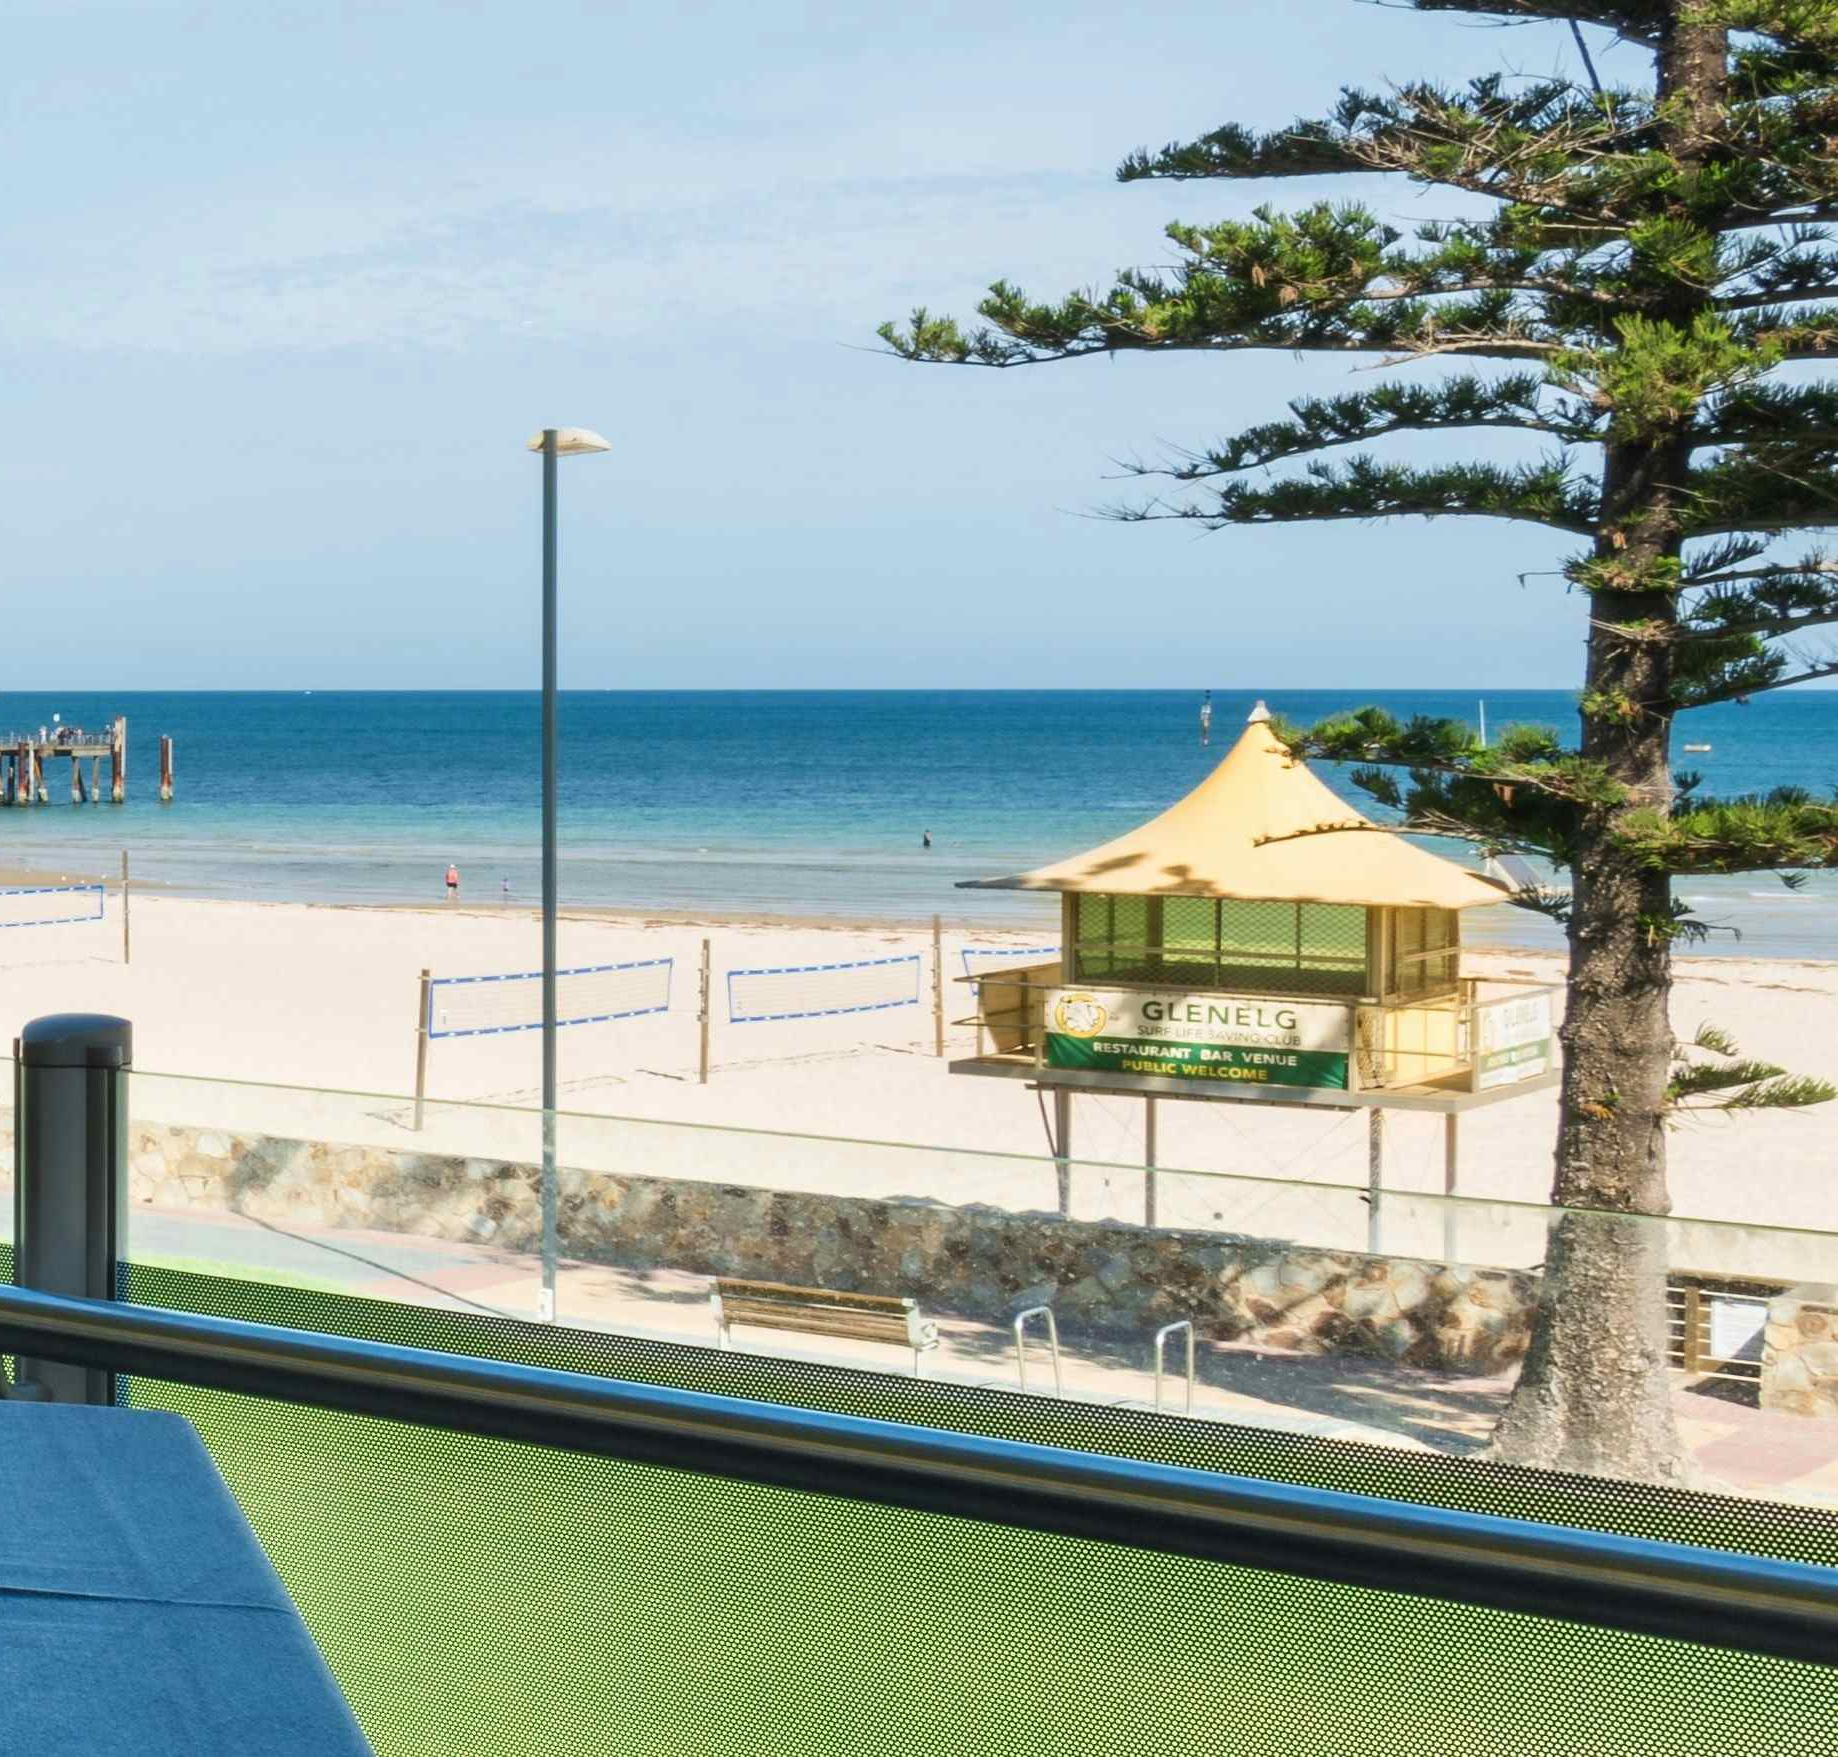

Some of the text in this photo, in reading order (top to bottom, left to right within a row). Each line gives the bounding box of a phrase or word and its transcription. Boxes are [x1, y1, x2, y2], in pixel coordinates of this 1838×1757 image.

[1143, 1001, 1297, 1030] GLENELG
[1137, 1025, 1301, 1046] SURF LIFE SAVING CLUB
[1093, 1042, 1298, 1067] RESTAURANT BAR VENUE
[1122, 1060, 1268, 1080] PUBLIC WELCOME
